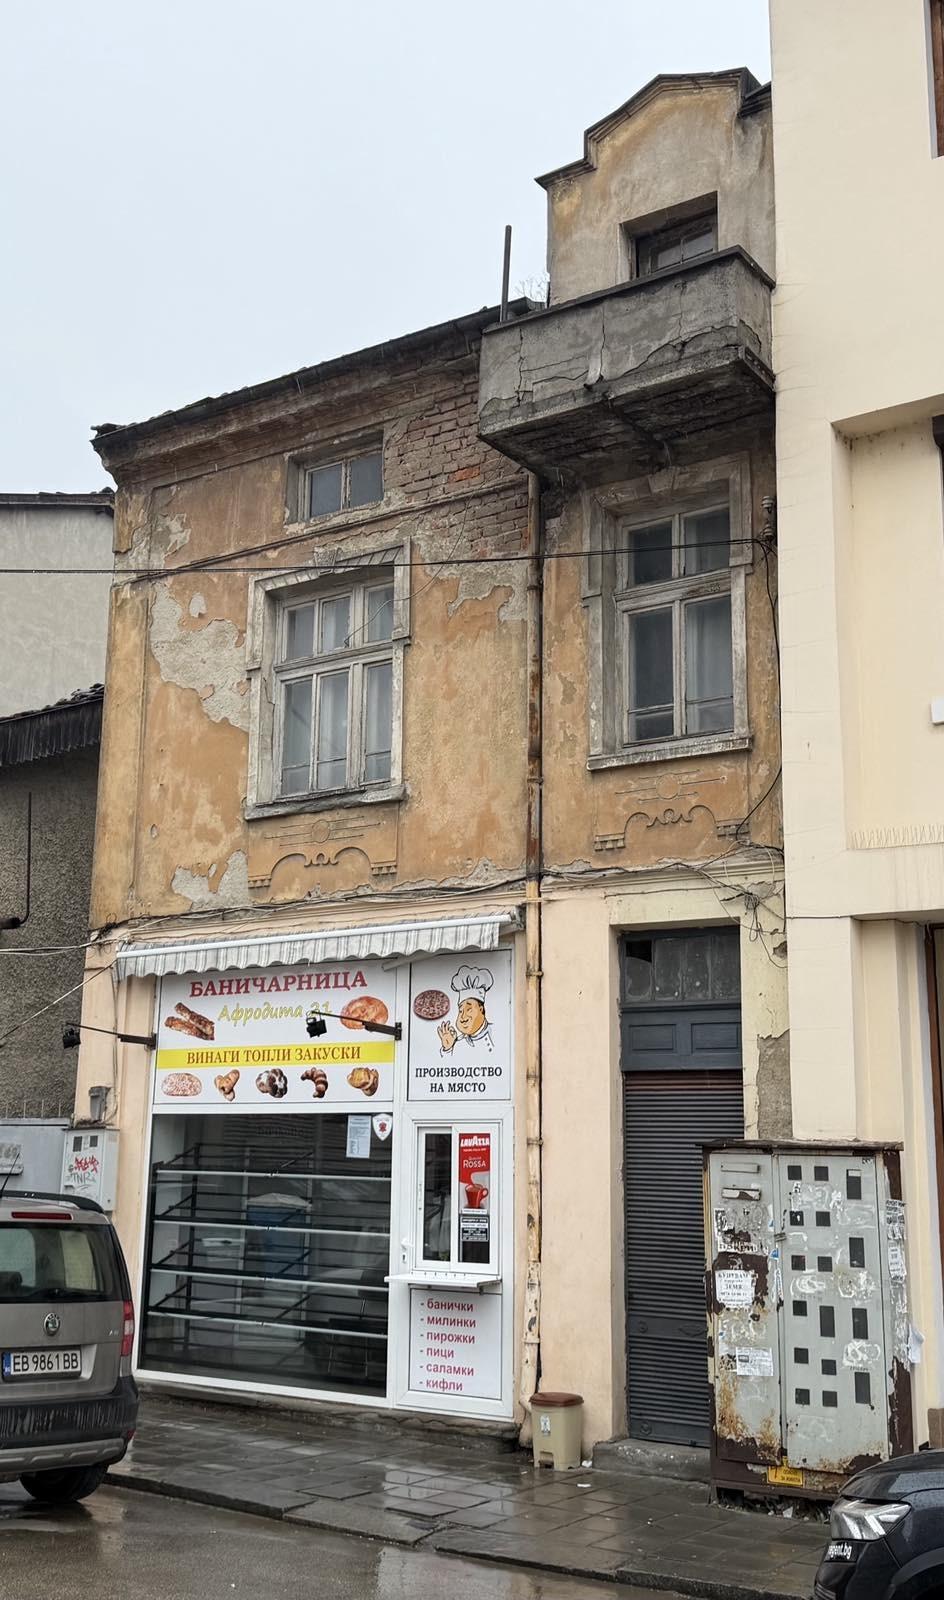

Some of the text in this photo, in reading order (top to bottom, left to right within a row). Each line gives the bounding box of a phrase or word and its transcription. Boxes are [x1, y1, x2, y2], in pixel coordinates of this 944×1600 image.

[189, 970, 368, 998] БАНИЧАРНИЦА
[217, 1001, 304, 1027] Афродита
[187, 1046, 361, 1065] ВИНАГИ ТОПЛИ ЗАКУСКИ
[415, 1066, 503, 1078] ПРОИЗВОДСТВО
[430, 1082, 486, 1093] НА МЯСТО
[427, 1298, 474, 1312] банички
[427, 1316, 476, 1328] милинки
[426, 1331, 475, 1344] пирожки
[426, 1347, 454, 1359] пици
[32, 1354, 59, 1371] 9861
[426, 1363, 474, 1376] саламки
[426, 1378, 463, 1392] кифли
